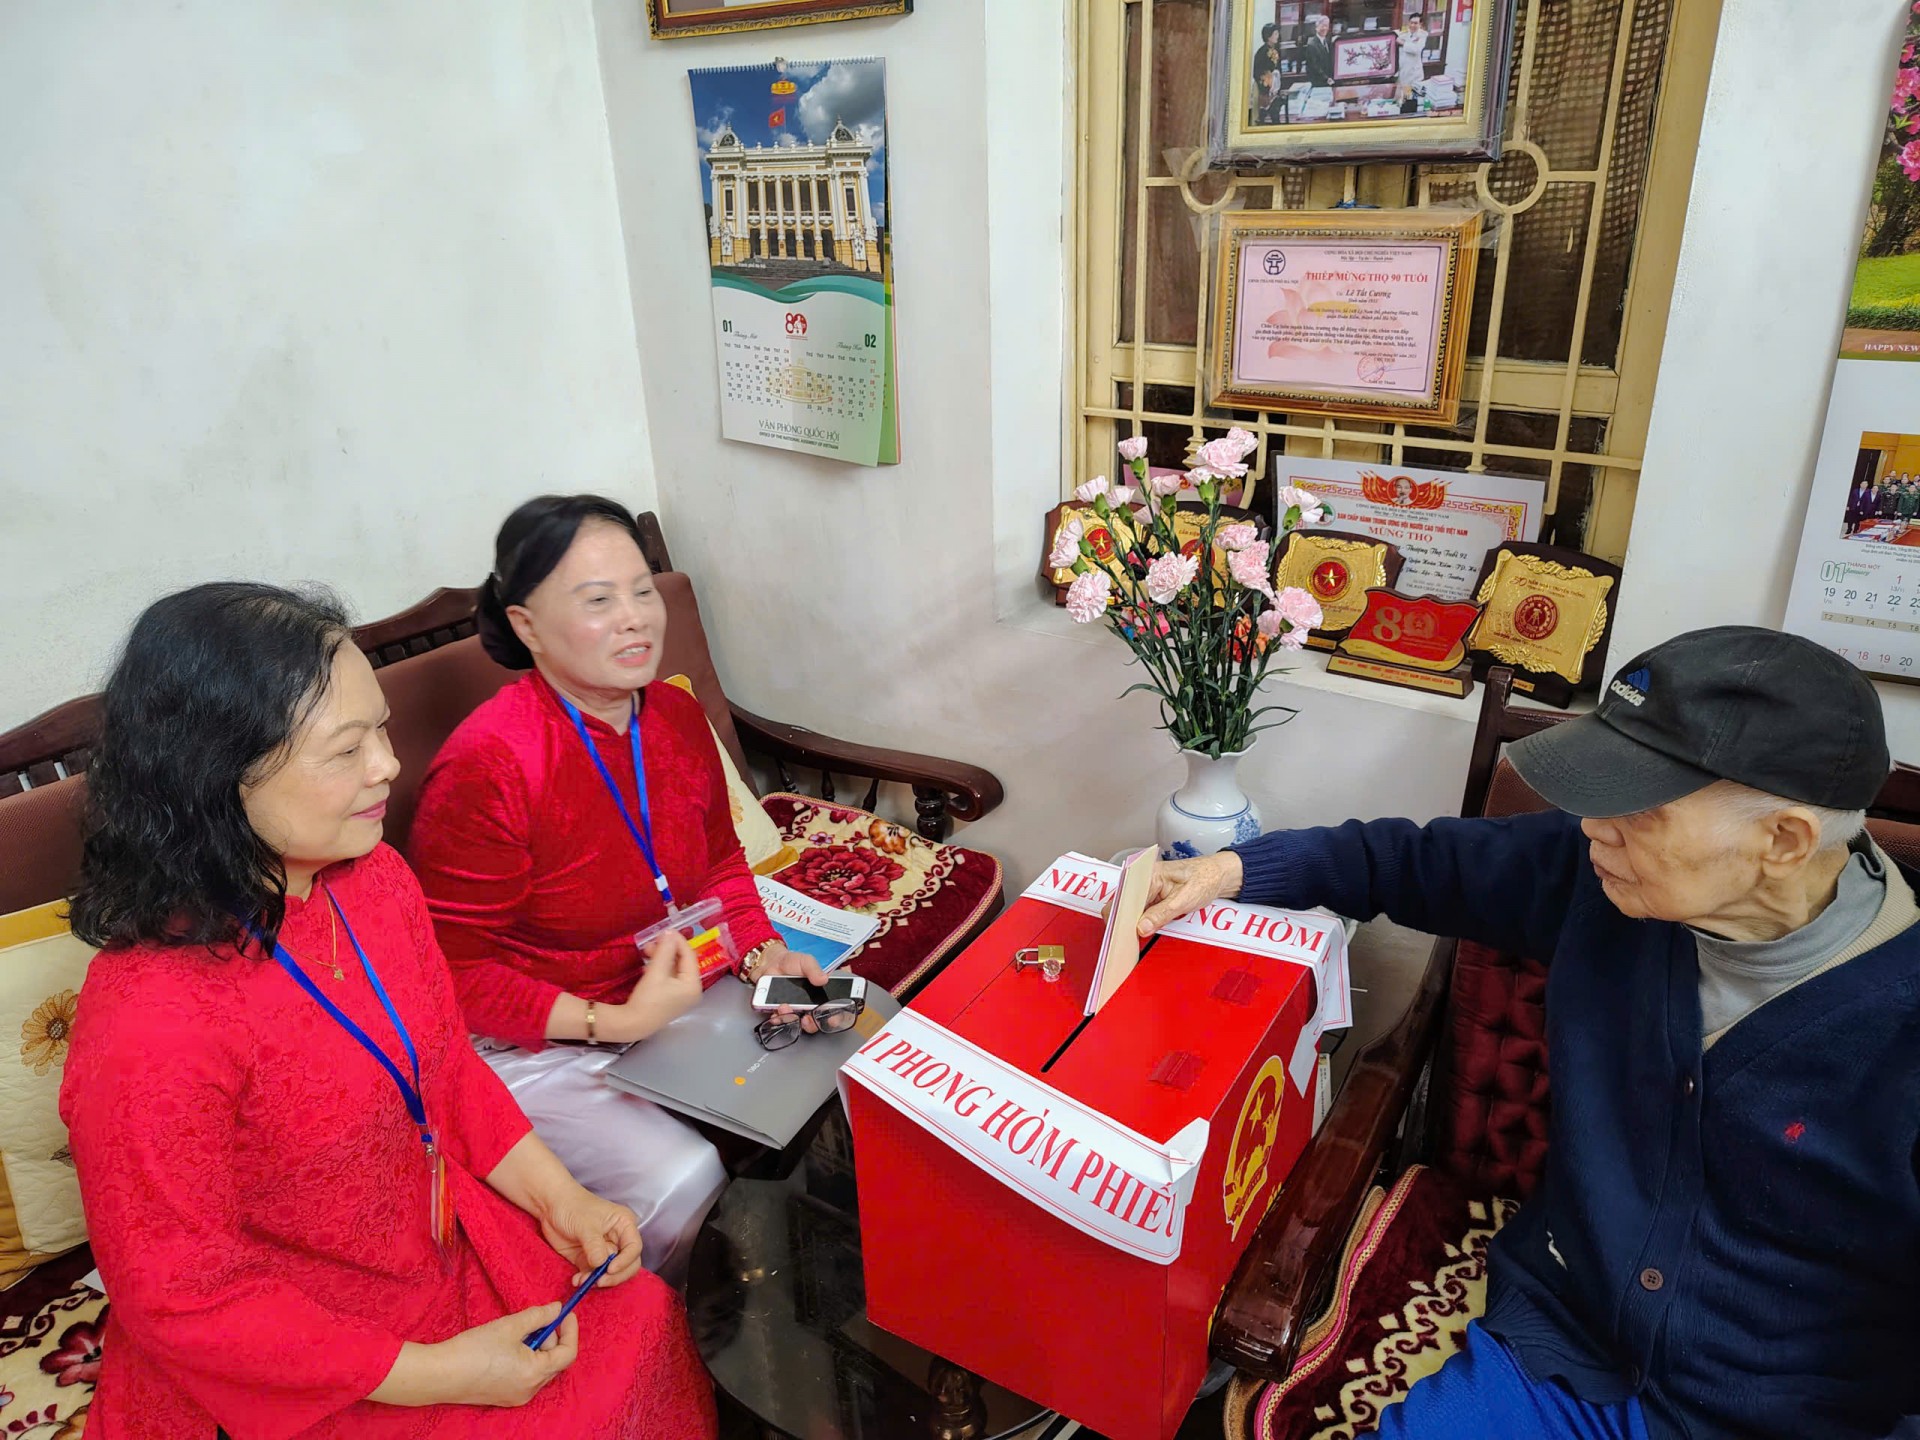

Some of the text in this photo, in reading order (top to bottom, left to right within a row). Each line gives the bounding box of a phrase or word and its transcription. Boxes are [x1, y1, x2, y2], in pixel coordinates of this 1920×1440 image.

[1369, 273, 1389, 282] THỌ
[723, 320, 732, 333] 01
[865, 334, 876, 348] 02
[759, 420, 776, 429] VĂN
[804, 426, 825, 438] QUỐC
[827, 431, 840, 441] HỘI
[1407, 531, 1433, 543] THỌ
[1446, 526, 1456, 536] VIỆT
[1820, 561, 1846, 583] 01
[1847, 561, 1866, 569] THÁNG
[1897, 576, 1902, 584] 1
[1824, 587, 1835, 596] 19
[1844, 590, 1856, 599] 20
[1865, 592, 1878, 602] 21
[1887, 595, 1901, 605] 22
[1837, 648, 1912, 666] 17 18 19 20
[1611, 680, 1646, 707] adidas
[785, 909, 813, 926] DÂN
[1239, 912, 1326, 952] HÒM
[872, 1038, 996, 1118] PHONG
[978, 1099, 1082, 1182] HÒM
